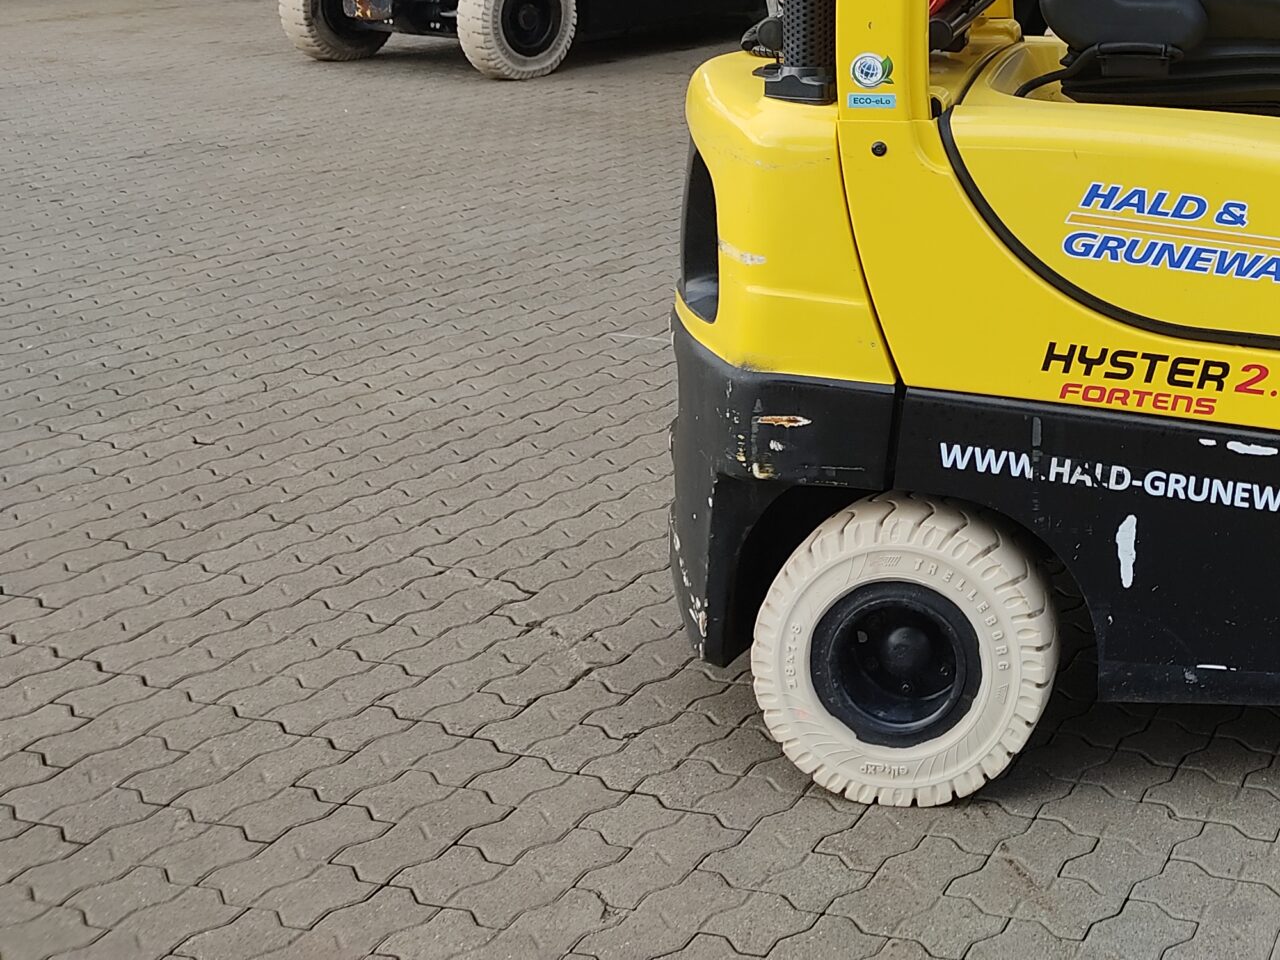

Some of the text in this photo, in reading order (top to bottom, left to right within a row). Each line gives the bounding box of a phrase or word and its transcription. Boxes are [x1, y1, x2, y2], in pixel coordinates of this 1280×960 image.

[853, 97, 892, 105] ECO-eLo
[1080, 183, 1249, 227] HALD &
[1041, 342, 1231, 392] HYSTER
[913, 558, 1011, 672] TRELLEBORG
